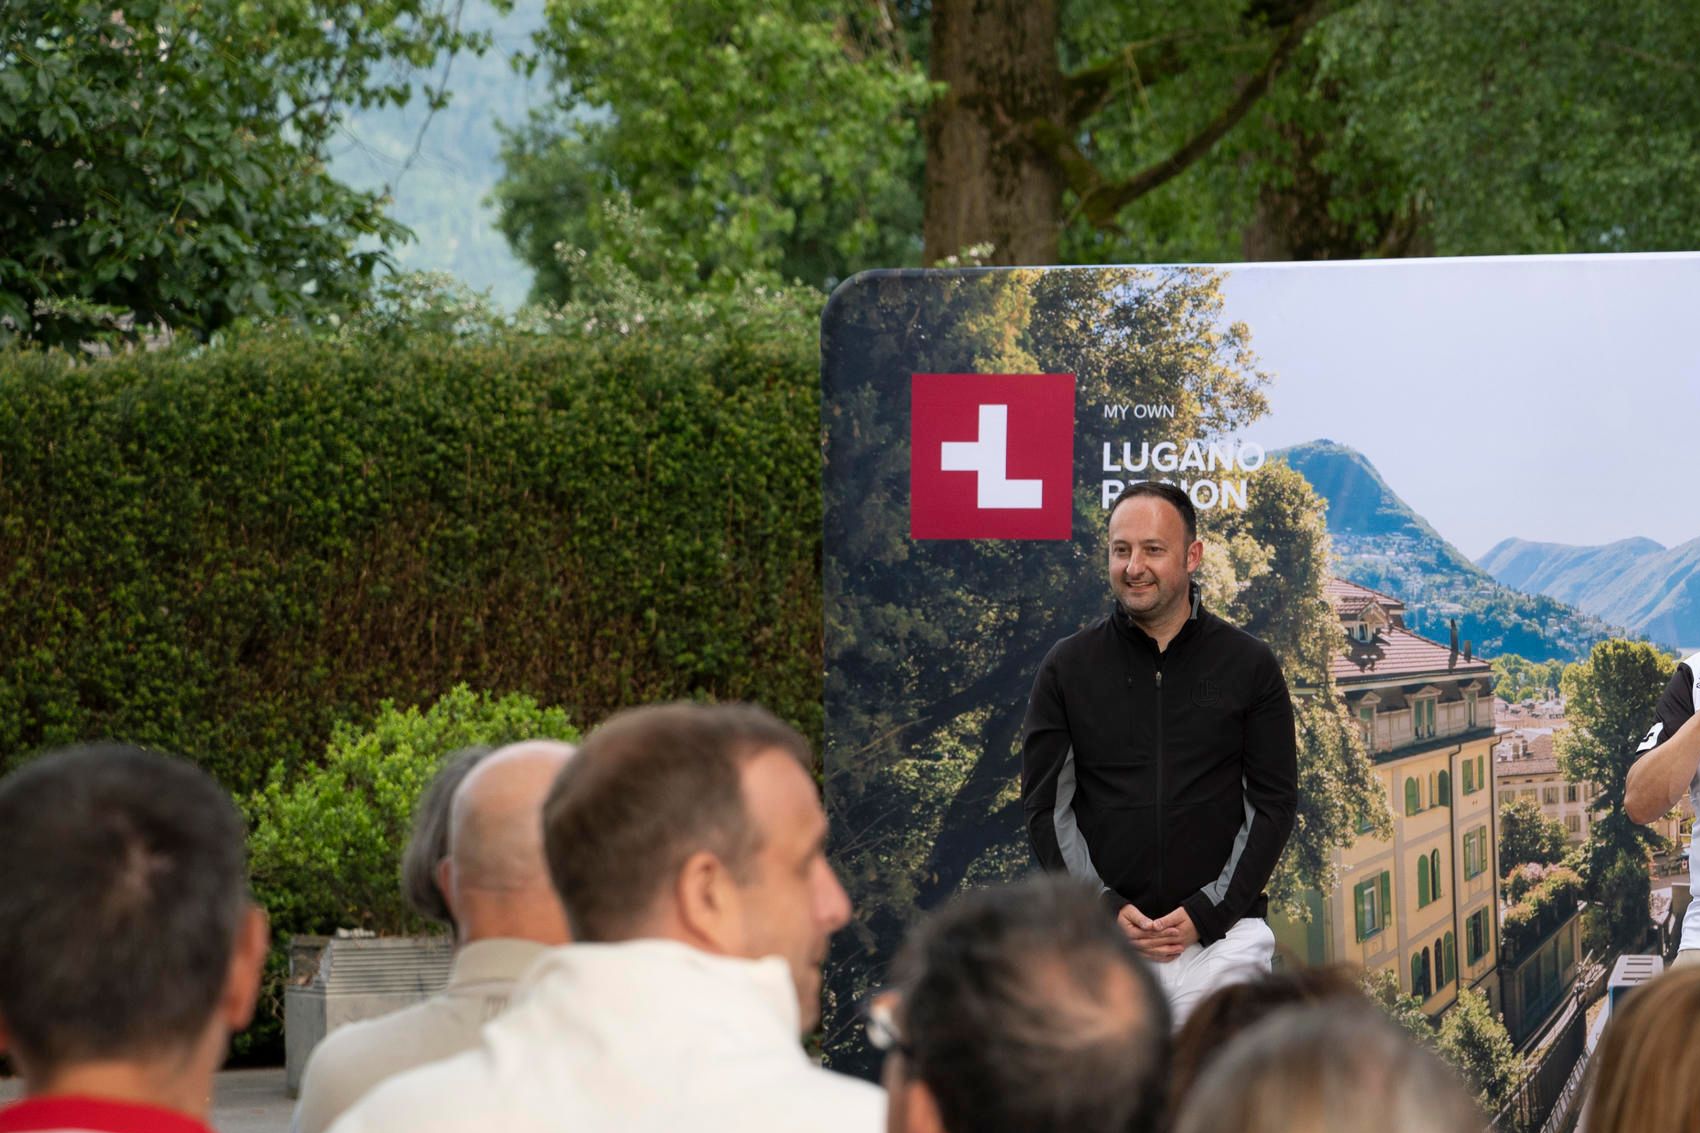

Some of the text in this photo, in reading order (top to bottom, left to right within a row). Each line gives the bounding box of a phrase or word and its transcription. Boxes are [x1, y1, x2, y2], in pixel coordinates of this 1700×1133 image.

[1104, 403, 1175, 420] MY OWN
[1103, 441, 1266, 473] LUGANO
